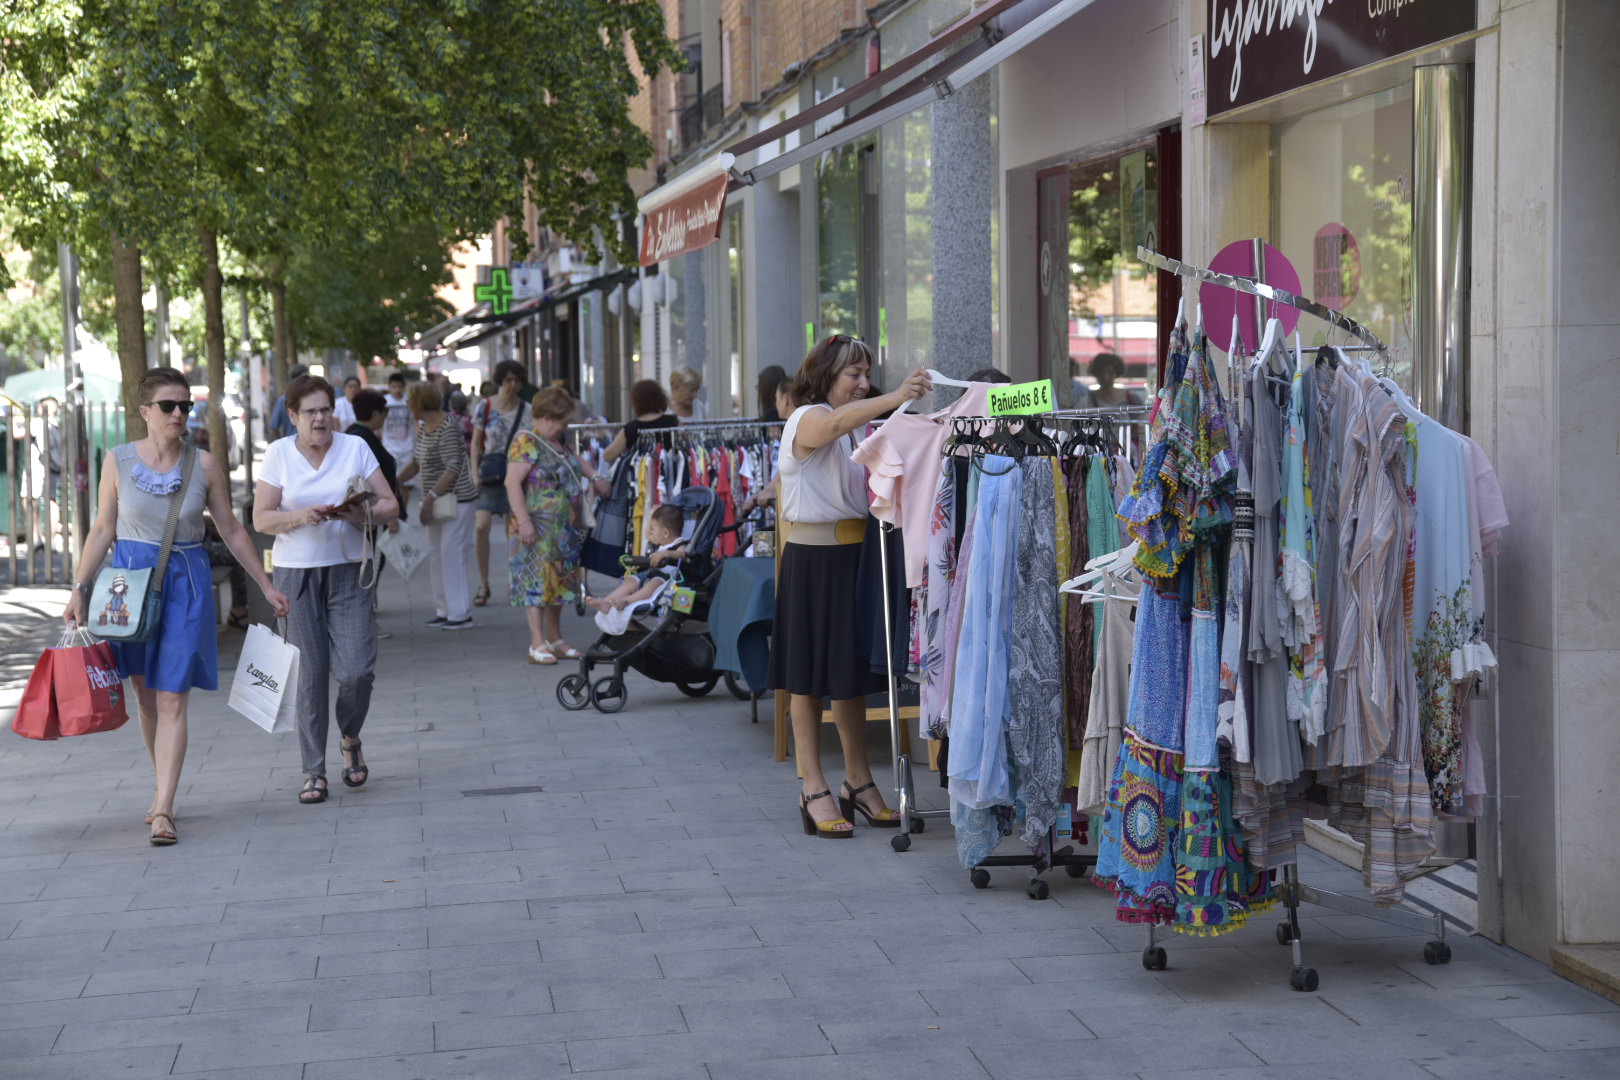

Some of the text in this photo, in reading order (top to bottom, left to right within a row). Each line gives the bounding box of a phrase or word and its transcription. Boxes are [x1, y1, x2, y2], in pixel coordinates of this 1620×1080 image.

[991, 386, 1047, 412] Pañuelos 8 €
